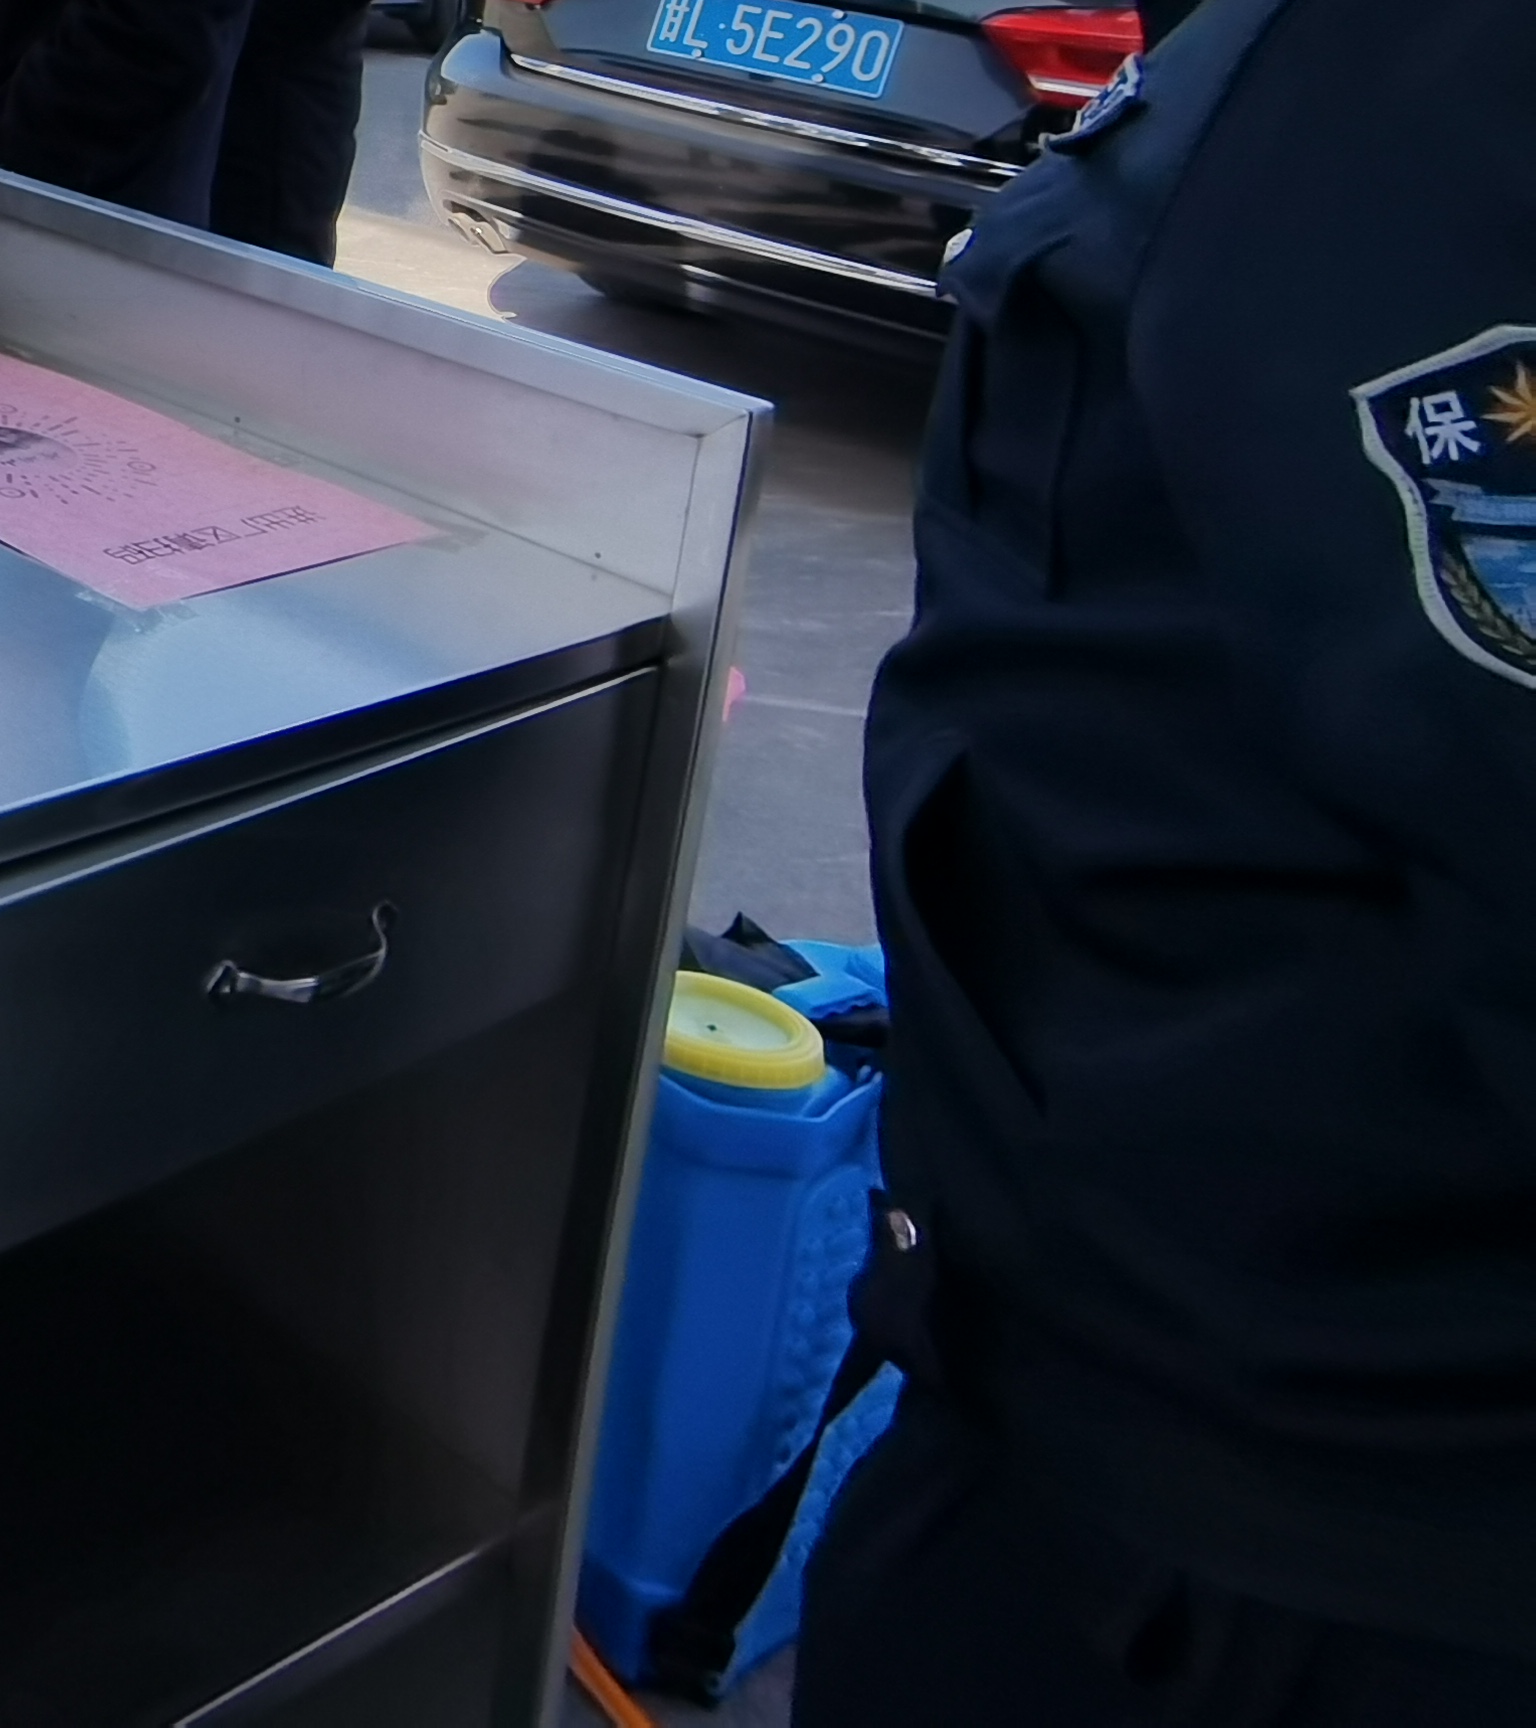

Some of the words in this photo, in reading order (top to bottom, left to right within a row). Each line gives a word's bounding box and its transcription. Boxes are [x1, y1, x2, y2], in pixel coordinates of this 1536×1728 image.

[1405, 389, 1482, 466] 保
[102, 505, 327, 566] 进出厂区请扫码
